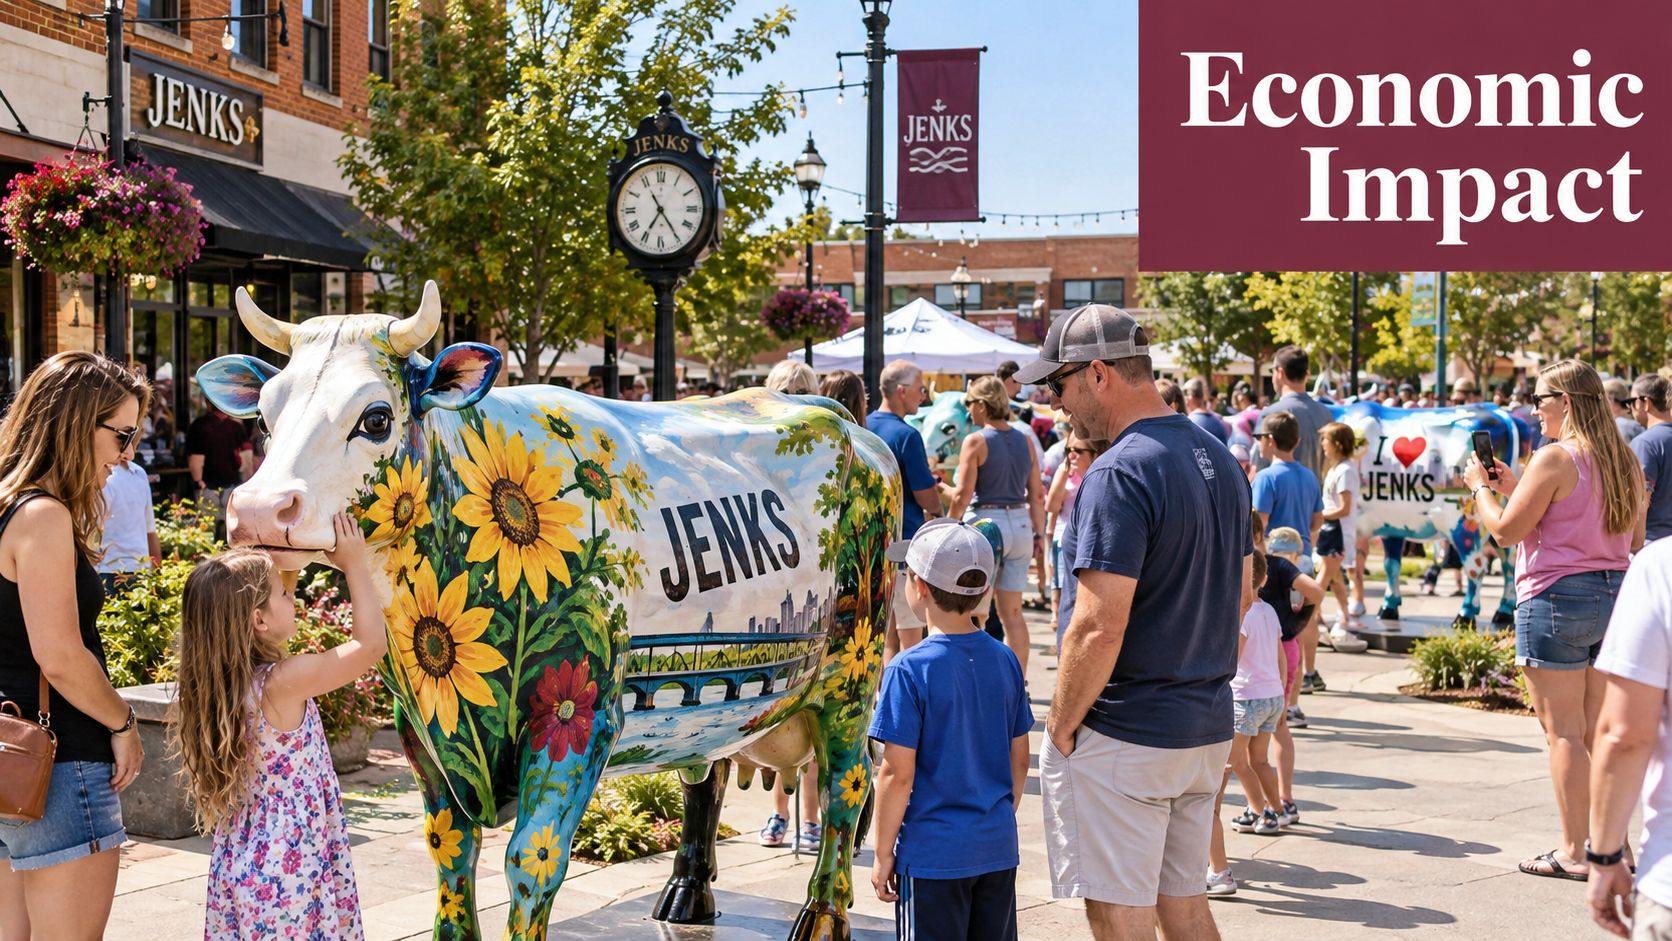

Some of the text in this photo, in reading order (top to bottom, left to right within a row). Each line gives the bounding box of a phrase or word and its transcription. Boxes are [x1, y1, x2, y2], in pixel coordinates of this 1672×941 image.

[148, 73, 244, 146] JENKS
[903, 114, 973, 144] JENKS
[633, 134, 690, 156] JENKS
[1373, 436, 1388, 465] I
[1362, 471, 1435, 502] JENKS
[659, 489, 800, 602] JENKS
